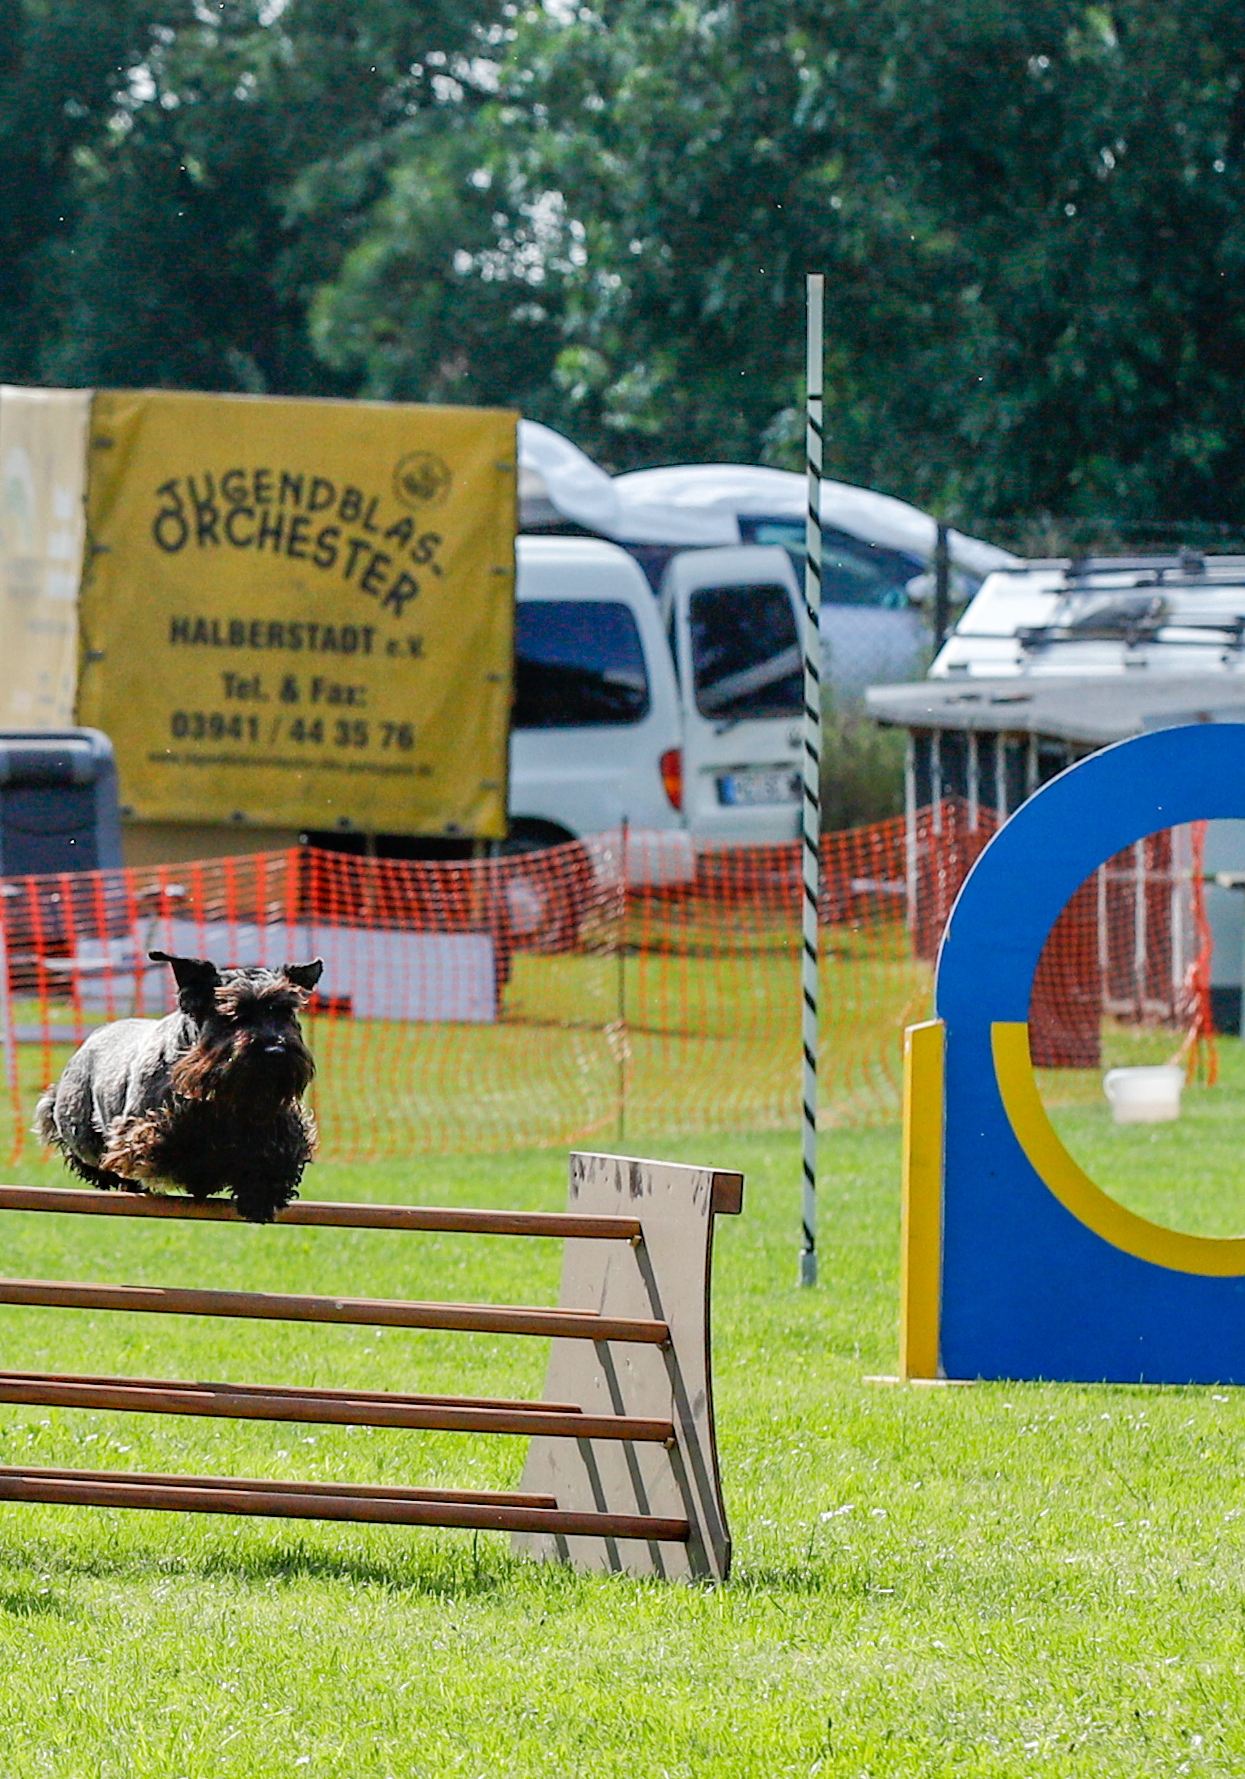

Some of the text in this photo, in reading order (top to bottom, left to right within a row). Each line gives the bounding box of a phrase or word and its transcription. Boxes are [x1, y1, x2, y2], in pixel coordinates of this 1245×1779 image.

[157, 467, 443, 577] JUGENDBLAS-
[152, 503, 421, 620] ORCHESTER
[170, 615, 377, 655] HALBERSTADT
[221, 670, 269, 702] Tel.
[310, 676, 367, 707] Fax:
[170, 709, 259, 742] 03941
[289, 717, 324, 744] 44
